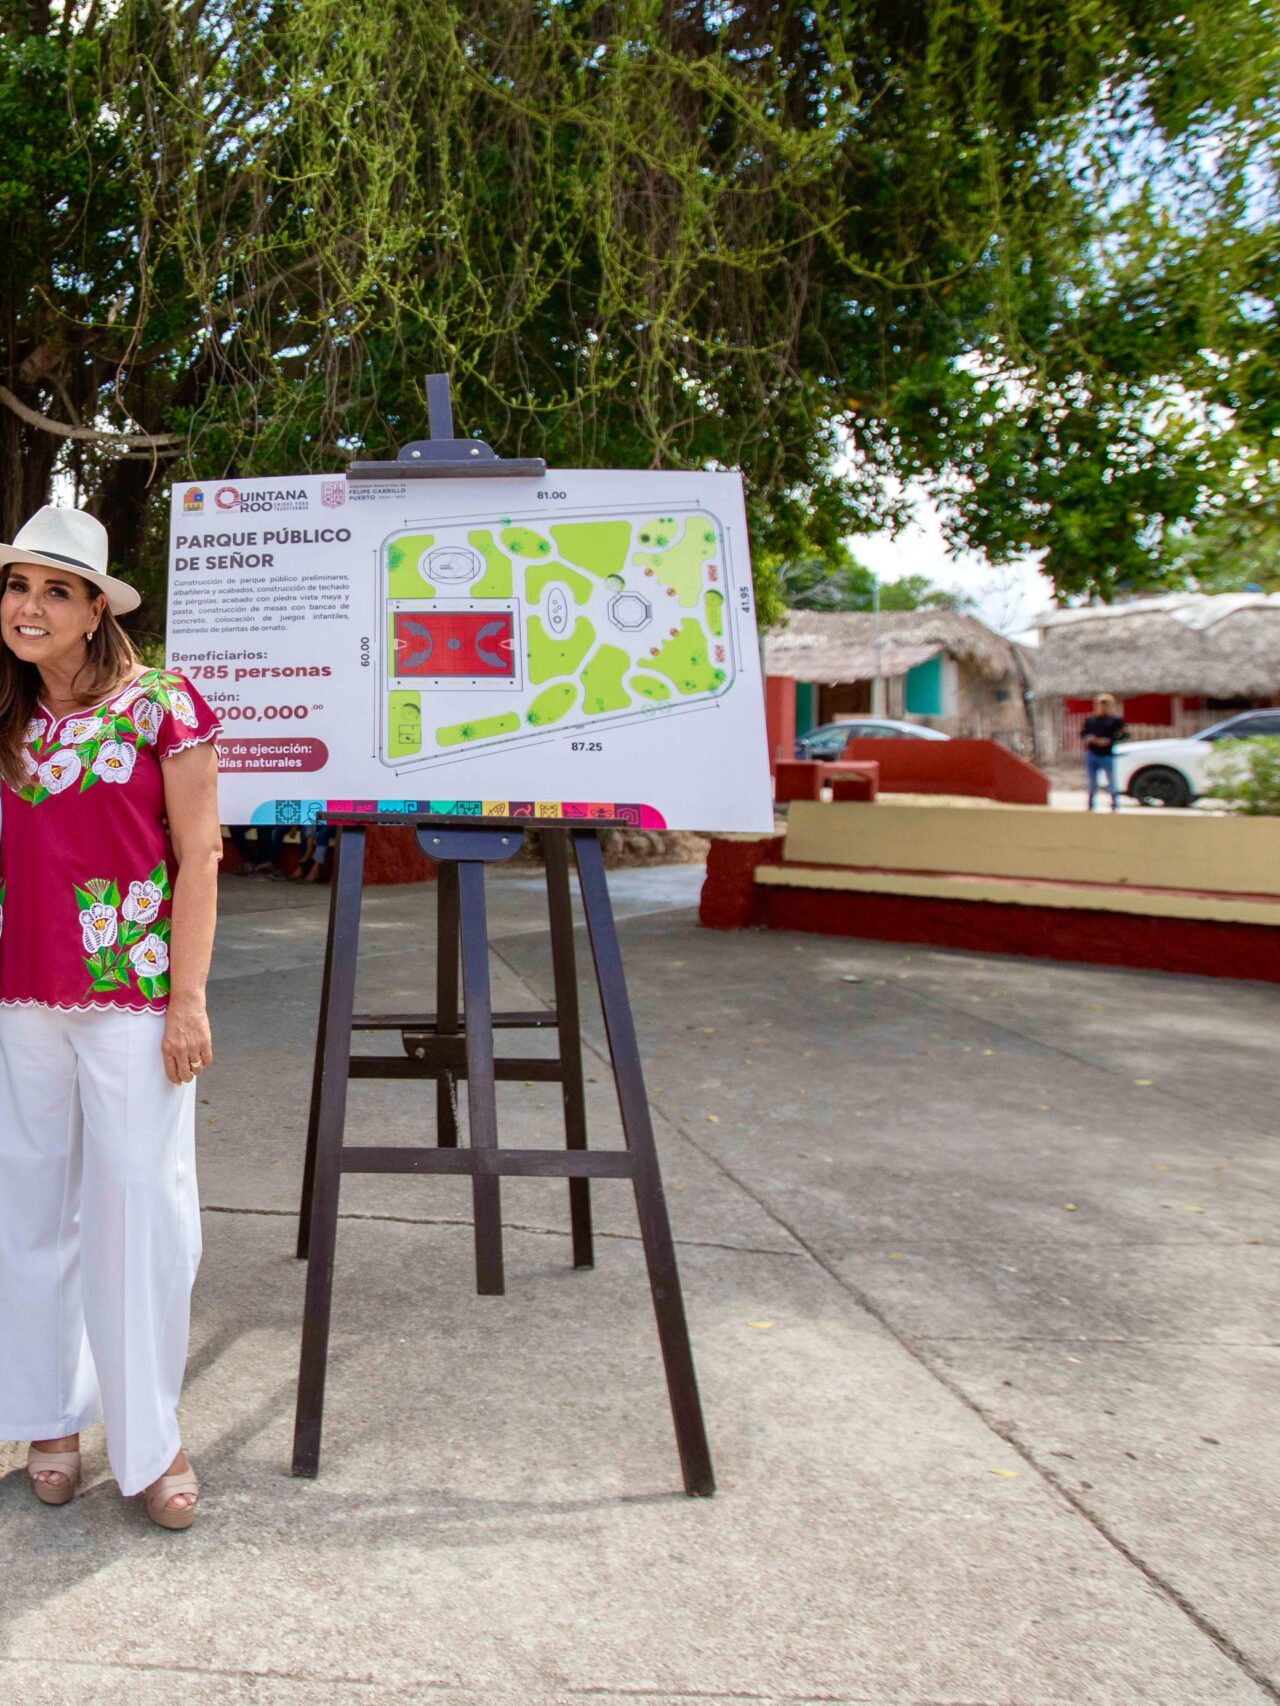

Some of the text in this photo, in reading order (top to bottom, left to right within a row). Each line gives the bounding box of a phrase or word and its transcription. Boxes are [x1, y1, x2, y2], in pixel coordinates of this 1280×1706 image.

[215, 487, 308, 509] QUINTANA
[537, 491, 566, 500] 81.00
[240, 502, 272, 513] ROO
[176, 527, 351, 549] PARQUE PÚBLICO
[175, 552, 274, 571] DE SEÑOR
[174, 578, 222, 587] Construcción
[240, 577, 266, 586] parque
[270, 575, 298, 584] público
[302, 574, 350, 582] preliminares,
[218, 586, 256, 594] acabados,
[256, 584, 306, 592] construcción
[318, 583, 350, 591] techado
[185, 597, 218, 607] pérgolas,
[273, 594, 297, 603] piedra
[740, 586, 750, 613] 41.95
[172, 608, 194, 616] pasta,
[198, 606, 247, 614] construcción
[214, 615, 256, 623] colocación
[280, 614, 306, 622] juegos
[312, 612, 350, 620] infantiles,
[172, 626, 208, 634] sembrado
[222, 625, 248, 634] plantas
[172, 650, 268, 662] Beneficiarios:
[360, 636, 370, 666] 60.00
[234, 665, 332, 682] personas
[232, 744, 247, 754] de
[250, 743, 312, 756] ejecución:
[571, 742, 603, 752] 87.25
[218, 756, 302, 768] días naturales
